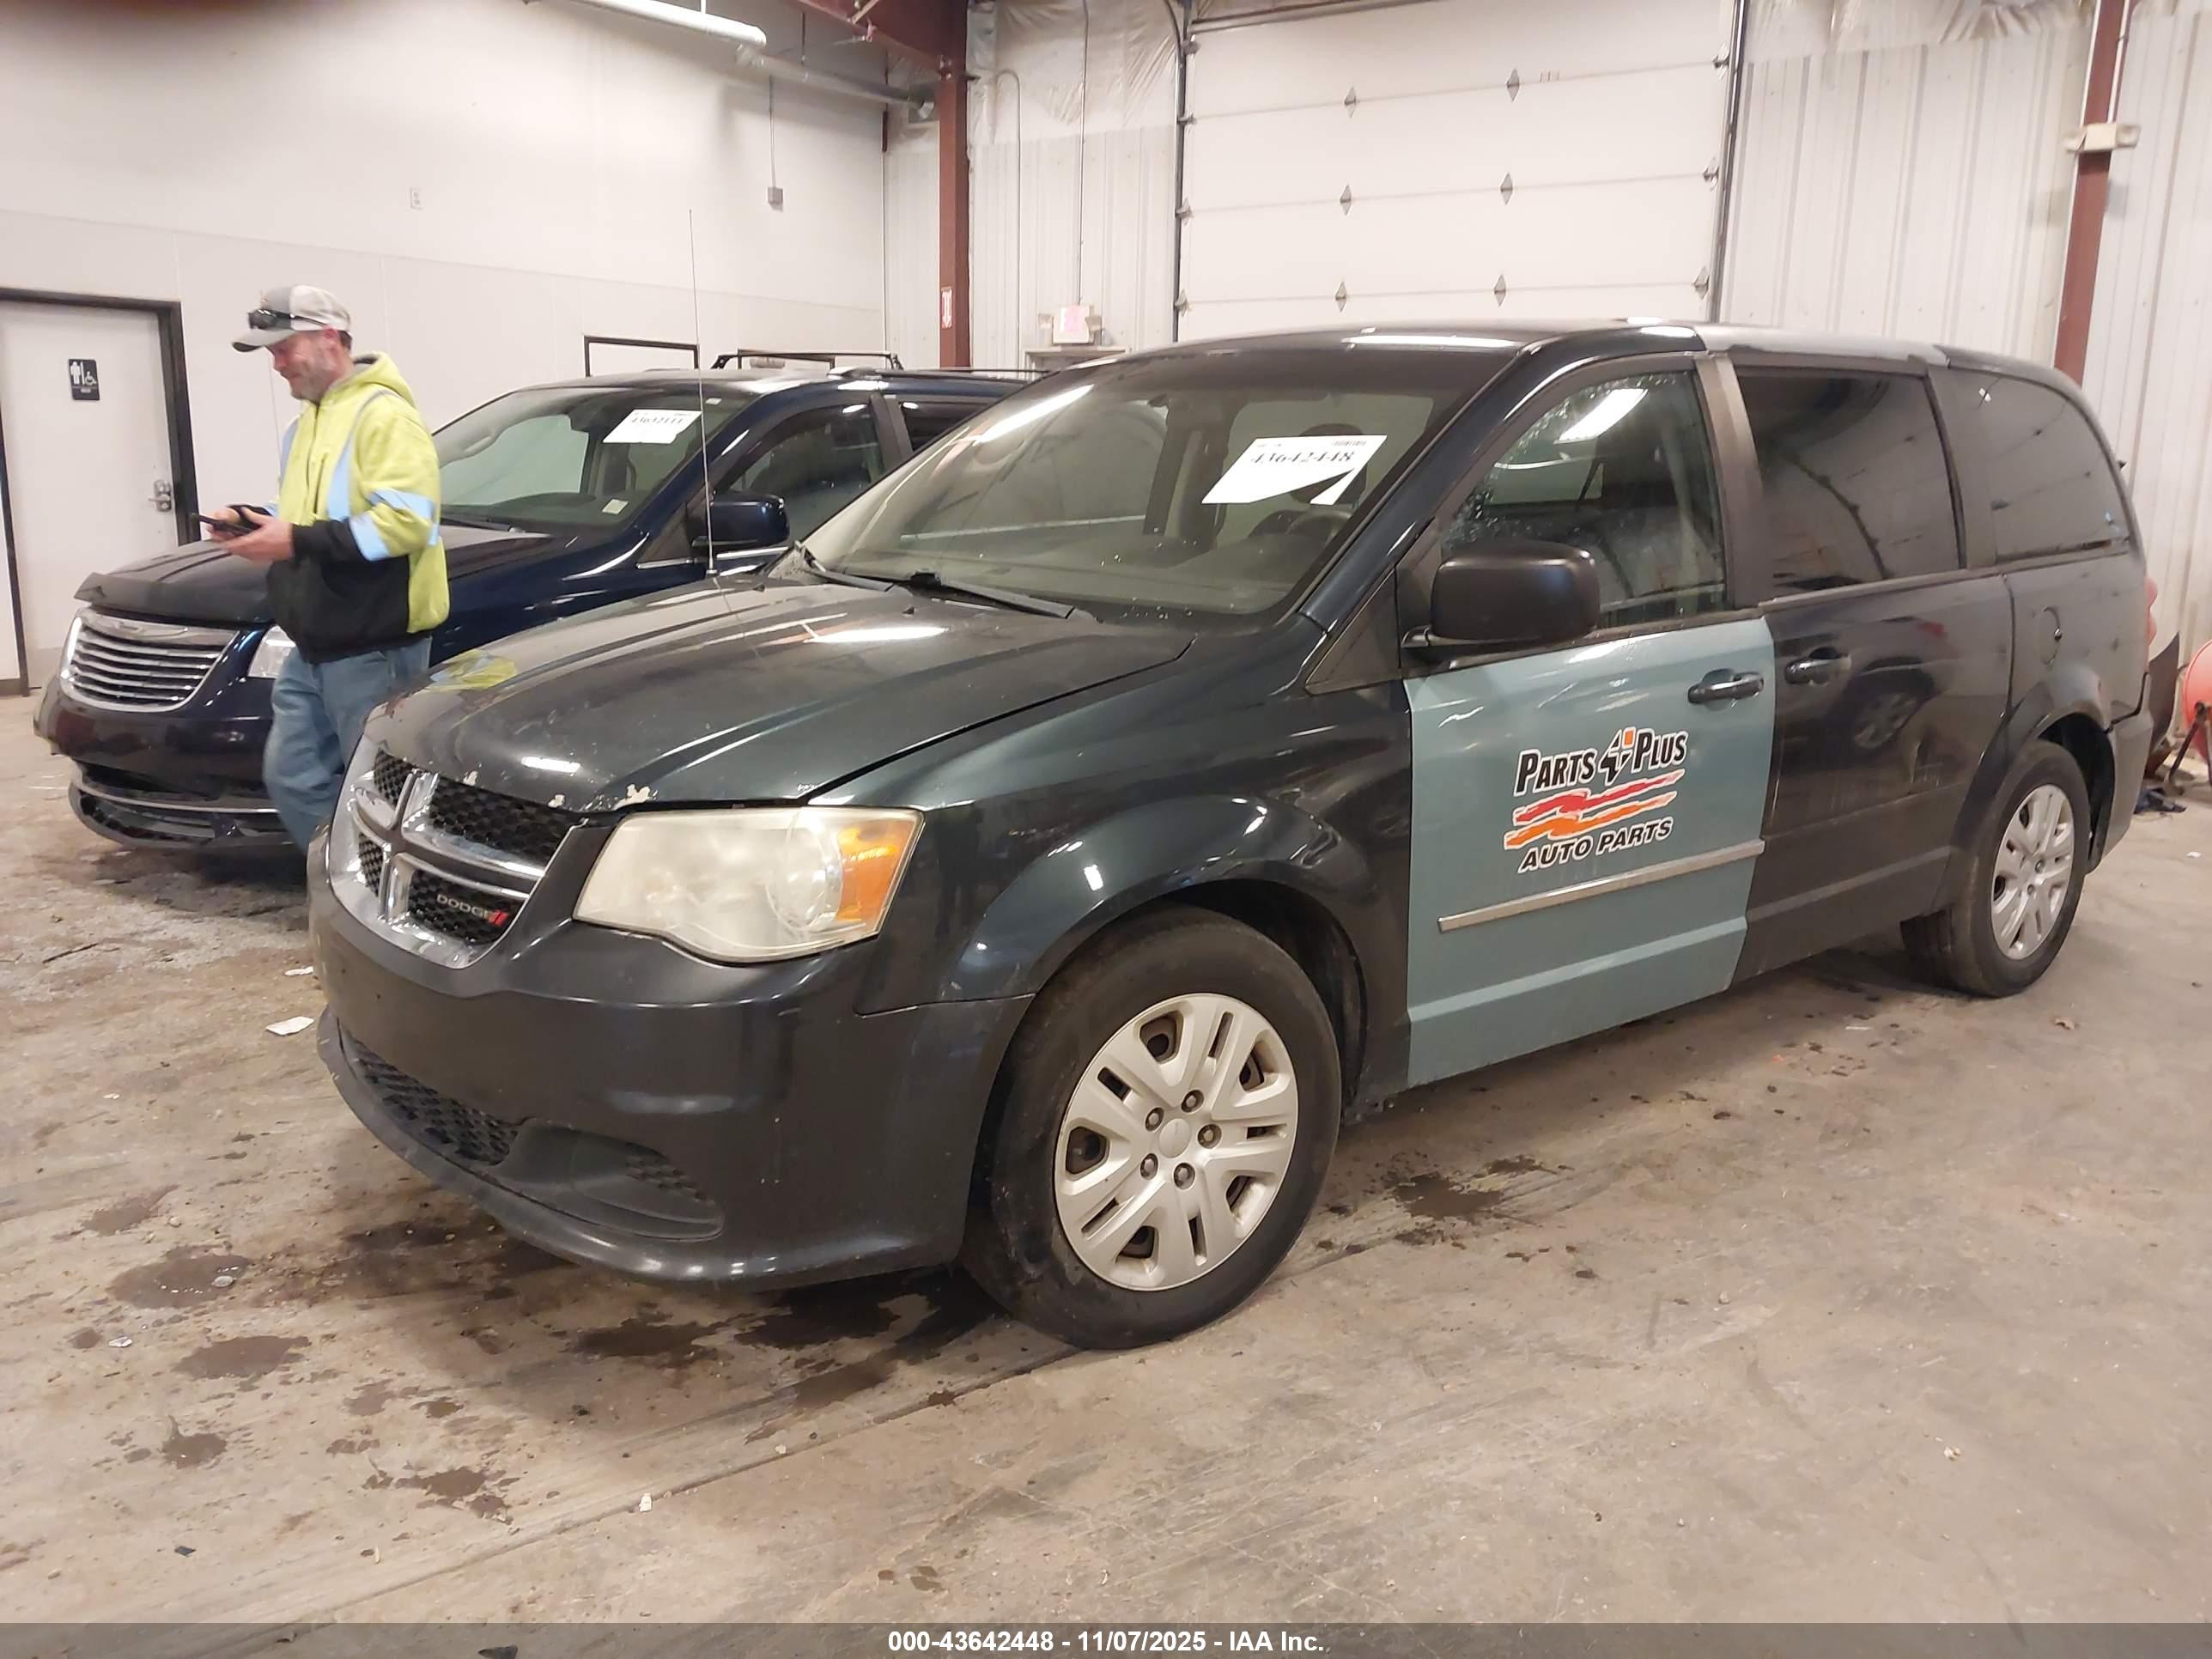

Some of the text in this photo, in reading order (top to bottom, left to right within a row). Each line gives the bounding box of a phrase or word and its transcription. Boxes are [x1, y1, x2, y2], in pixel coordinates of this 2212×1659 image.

[1249, 451, 1355, 465] 43642448
[1520, 819, 1673, 871] AUTO PARTS
